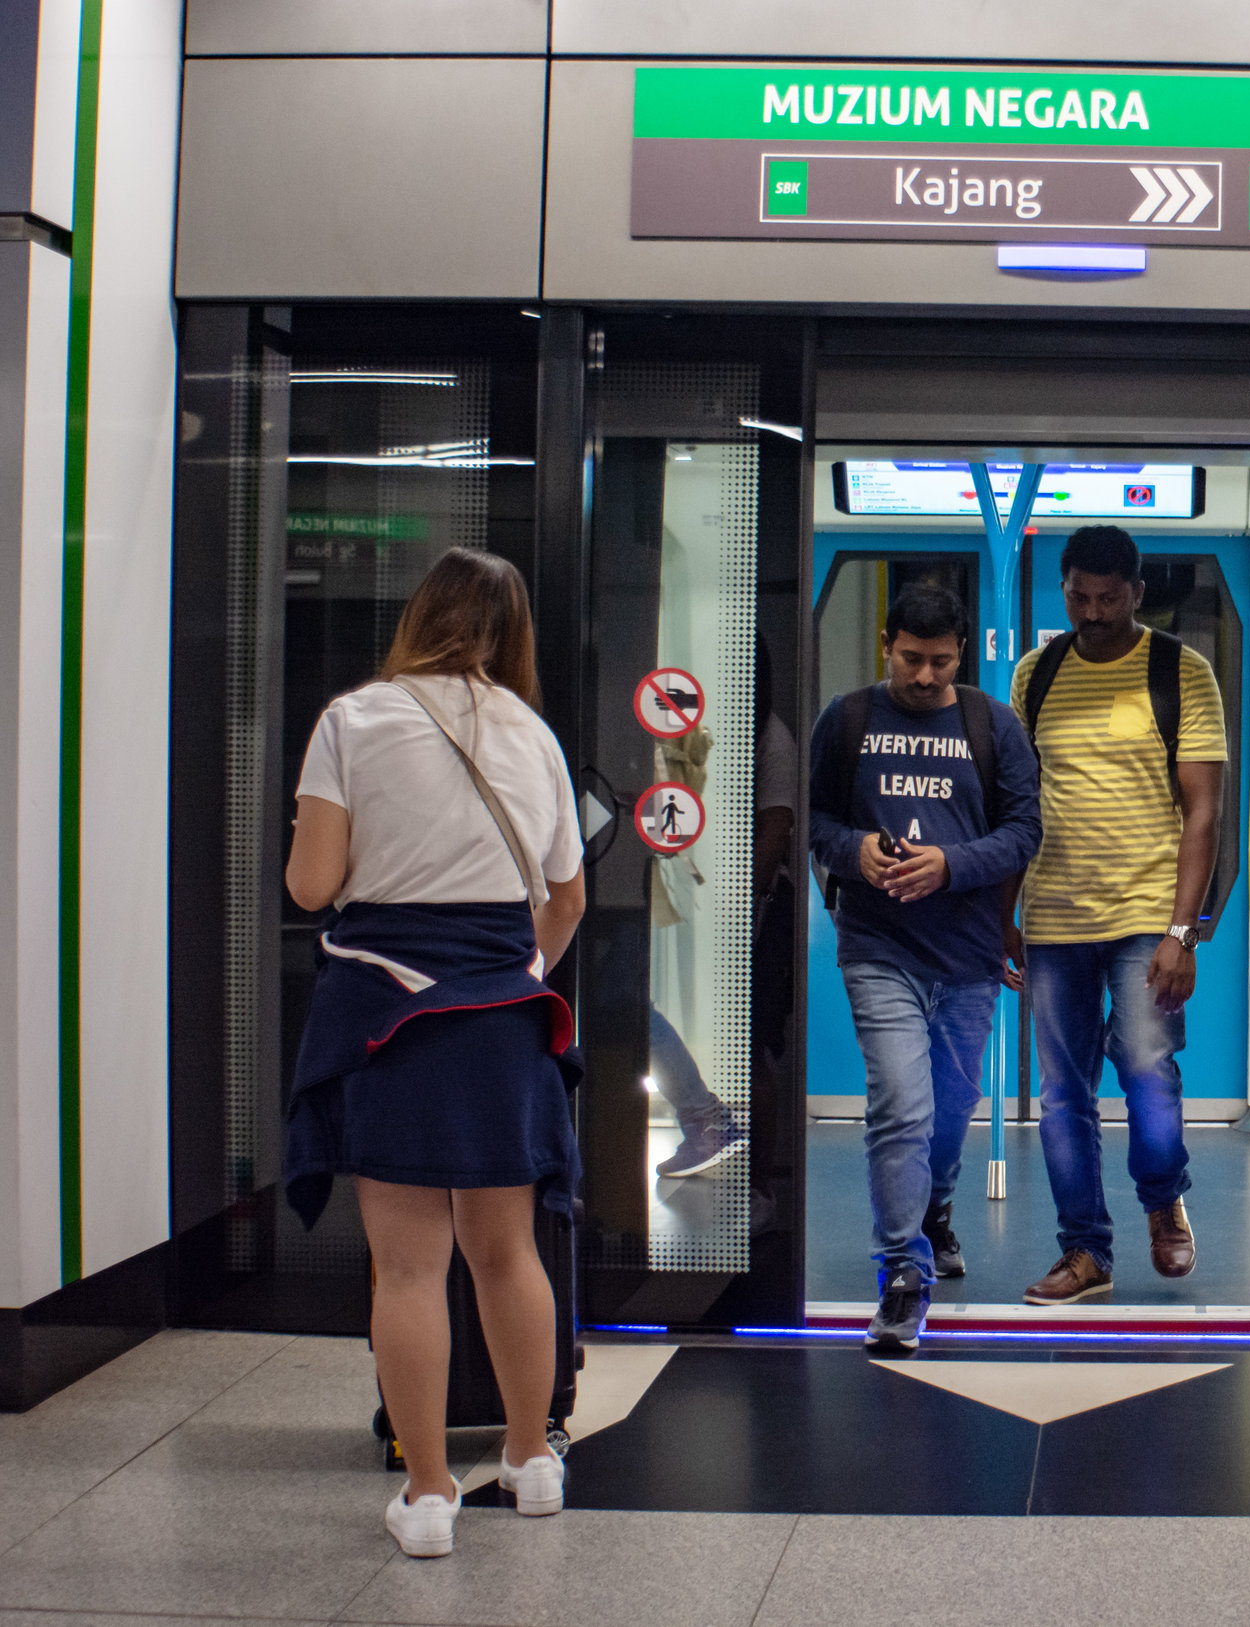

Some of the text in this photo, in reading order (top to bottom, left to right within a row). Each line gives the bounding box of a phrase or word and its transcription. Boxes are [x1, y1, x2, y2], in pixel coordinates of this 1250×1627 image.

[762, 84, 1150, 132] MUZIUM NEGARA
[774, 182, 802, 195] SBK
[895, 167, 1043, 219] Kajang
[880, 774, 952, 799] LEAVES
[908, 818, 921, 840] A
